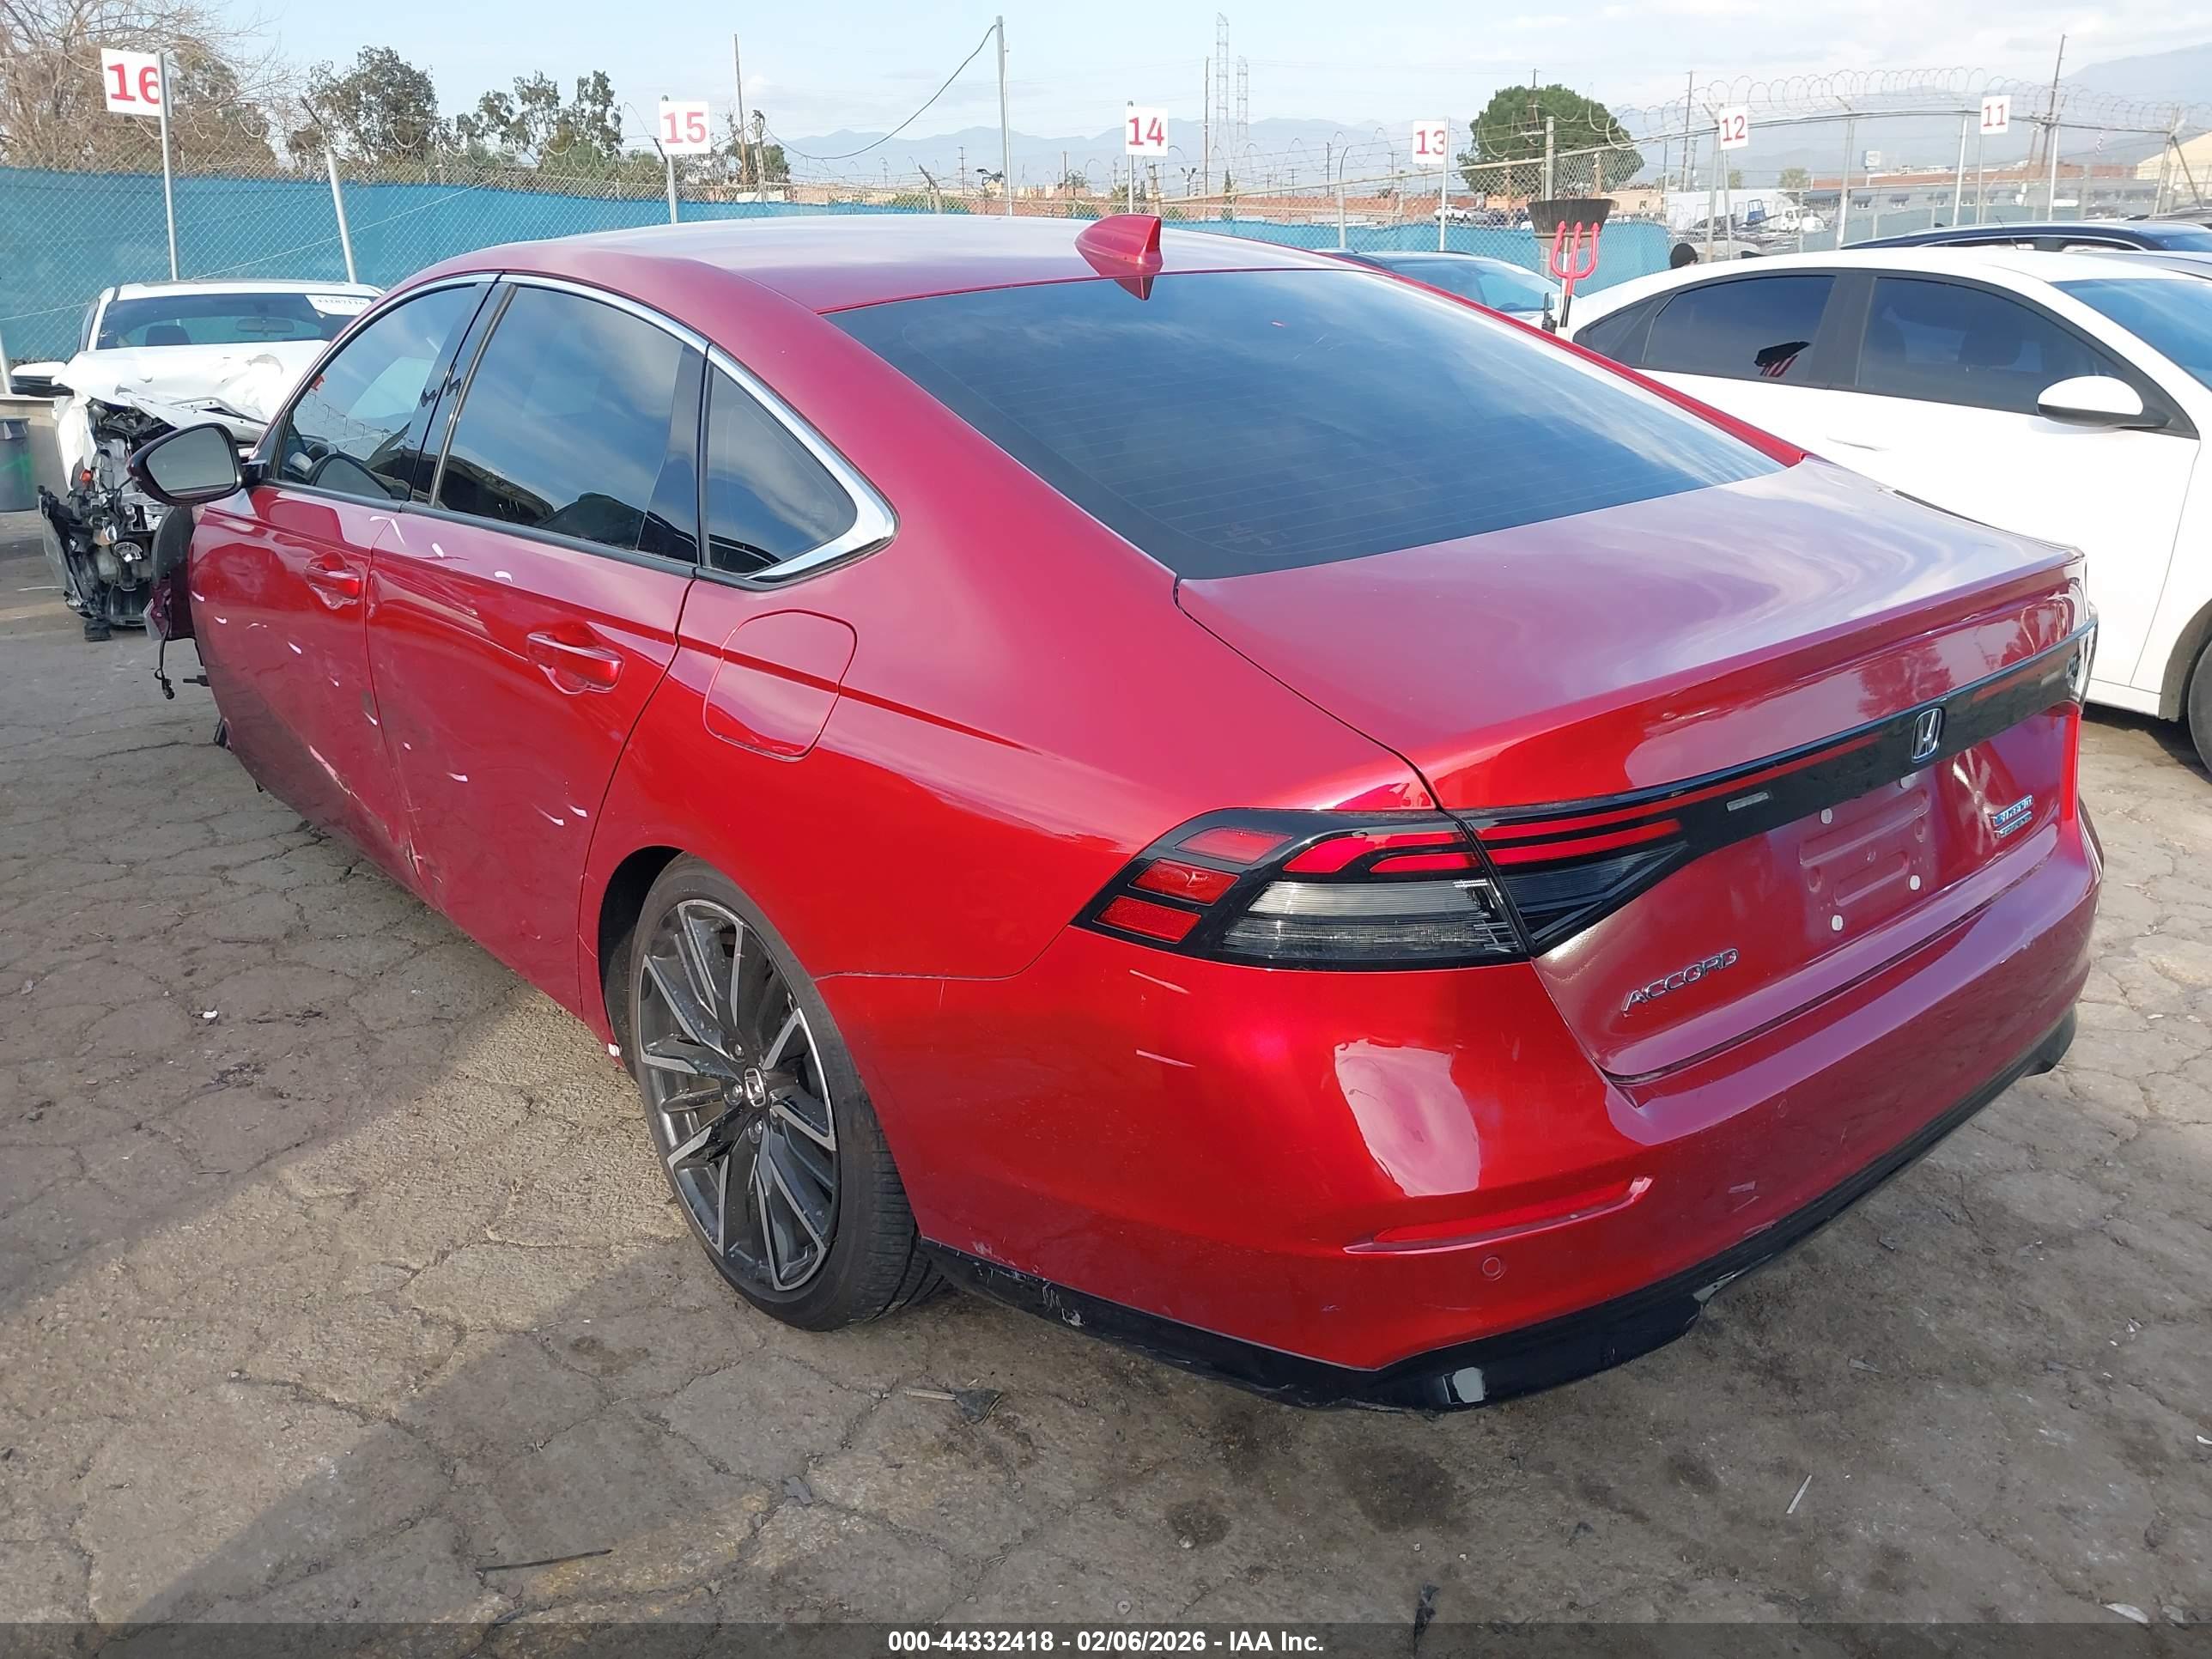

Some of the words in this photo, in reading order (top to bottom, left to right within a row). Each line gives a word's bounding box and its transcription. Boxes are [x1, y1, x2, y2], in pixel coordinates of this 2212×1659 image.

[107, 63, 161, 104] 16
[663, 112, 706, 143] 15
[1722, 115, 1746, 142] 12
[1983, 103, 2006, 127] 11
[1128, 116, 1164, 146] 14
[1416, 130, 1445, 155] 13
[1621, 948, 1739, 1012] ACCORD
